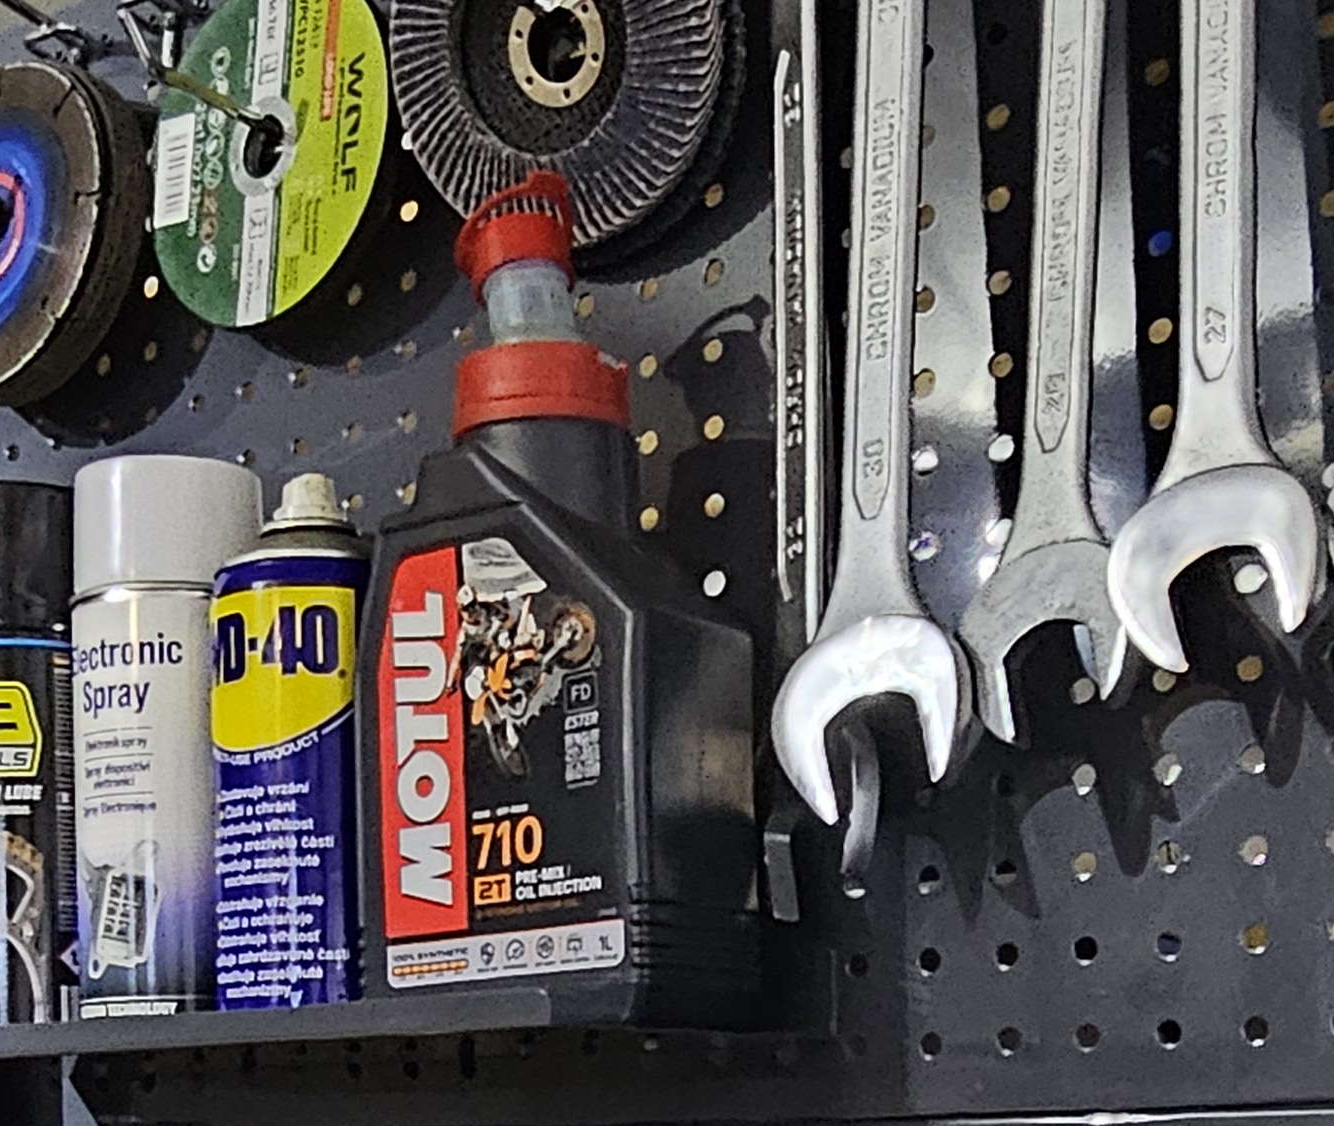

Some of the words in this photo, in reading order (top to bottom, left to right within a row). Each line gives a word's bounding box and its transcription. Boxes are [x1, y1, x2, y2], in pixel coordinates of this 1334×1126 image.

[869, 98, 897, 242] VANADIUM
[1204, 112, 1230, 218] CHROM
[865, 253, 891, 362] CHROM
[1203, 306, 1228, 346] 27
[214, 604, 341, 688] D-40
[82, 680, 151, 719] Spray
[570, 682, 592, 702] FD
[253, 730, 320, 764] PRODUCT
[391, 590, 454, 906] MOTUL
[471, 814, 543, 871] 710
[479, 878, 507, 901] 2T
[514, 865, 565, 886] PRE-MIX
[514, 886, 537, 901] OIL
[538, 875, 602, 898] INJECTION
